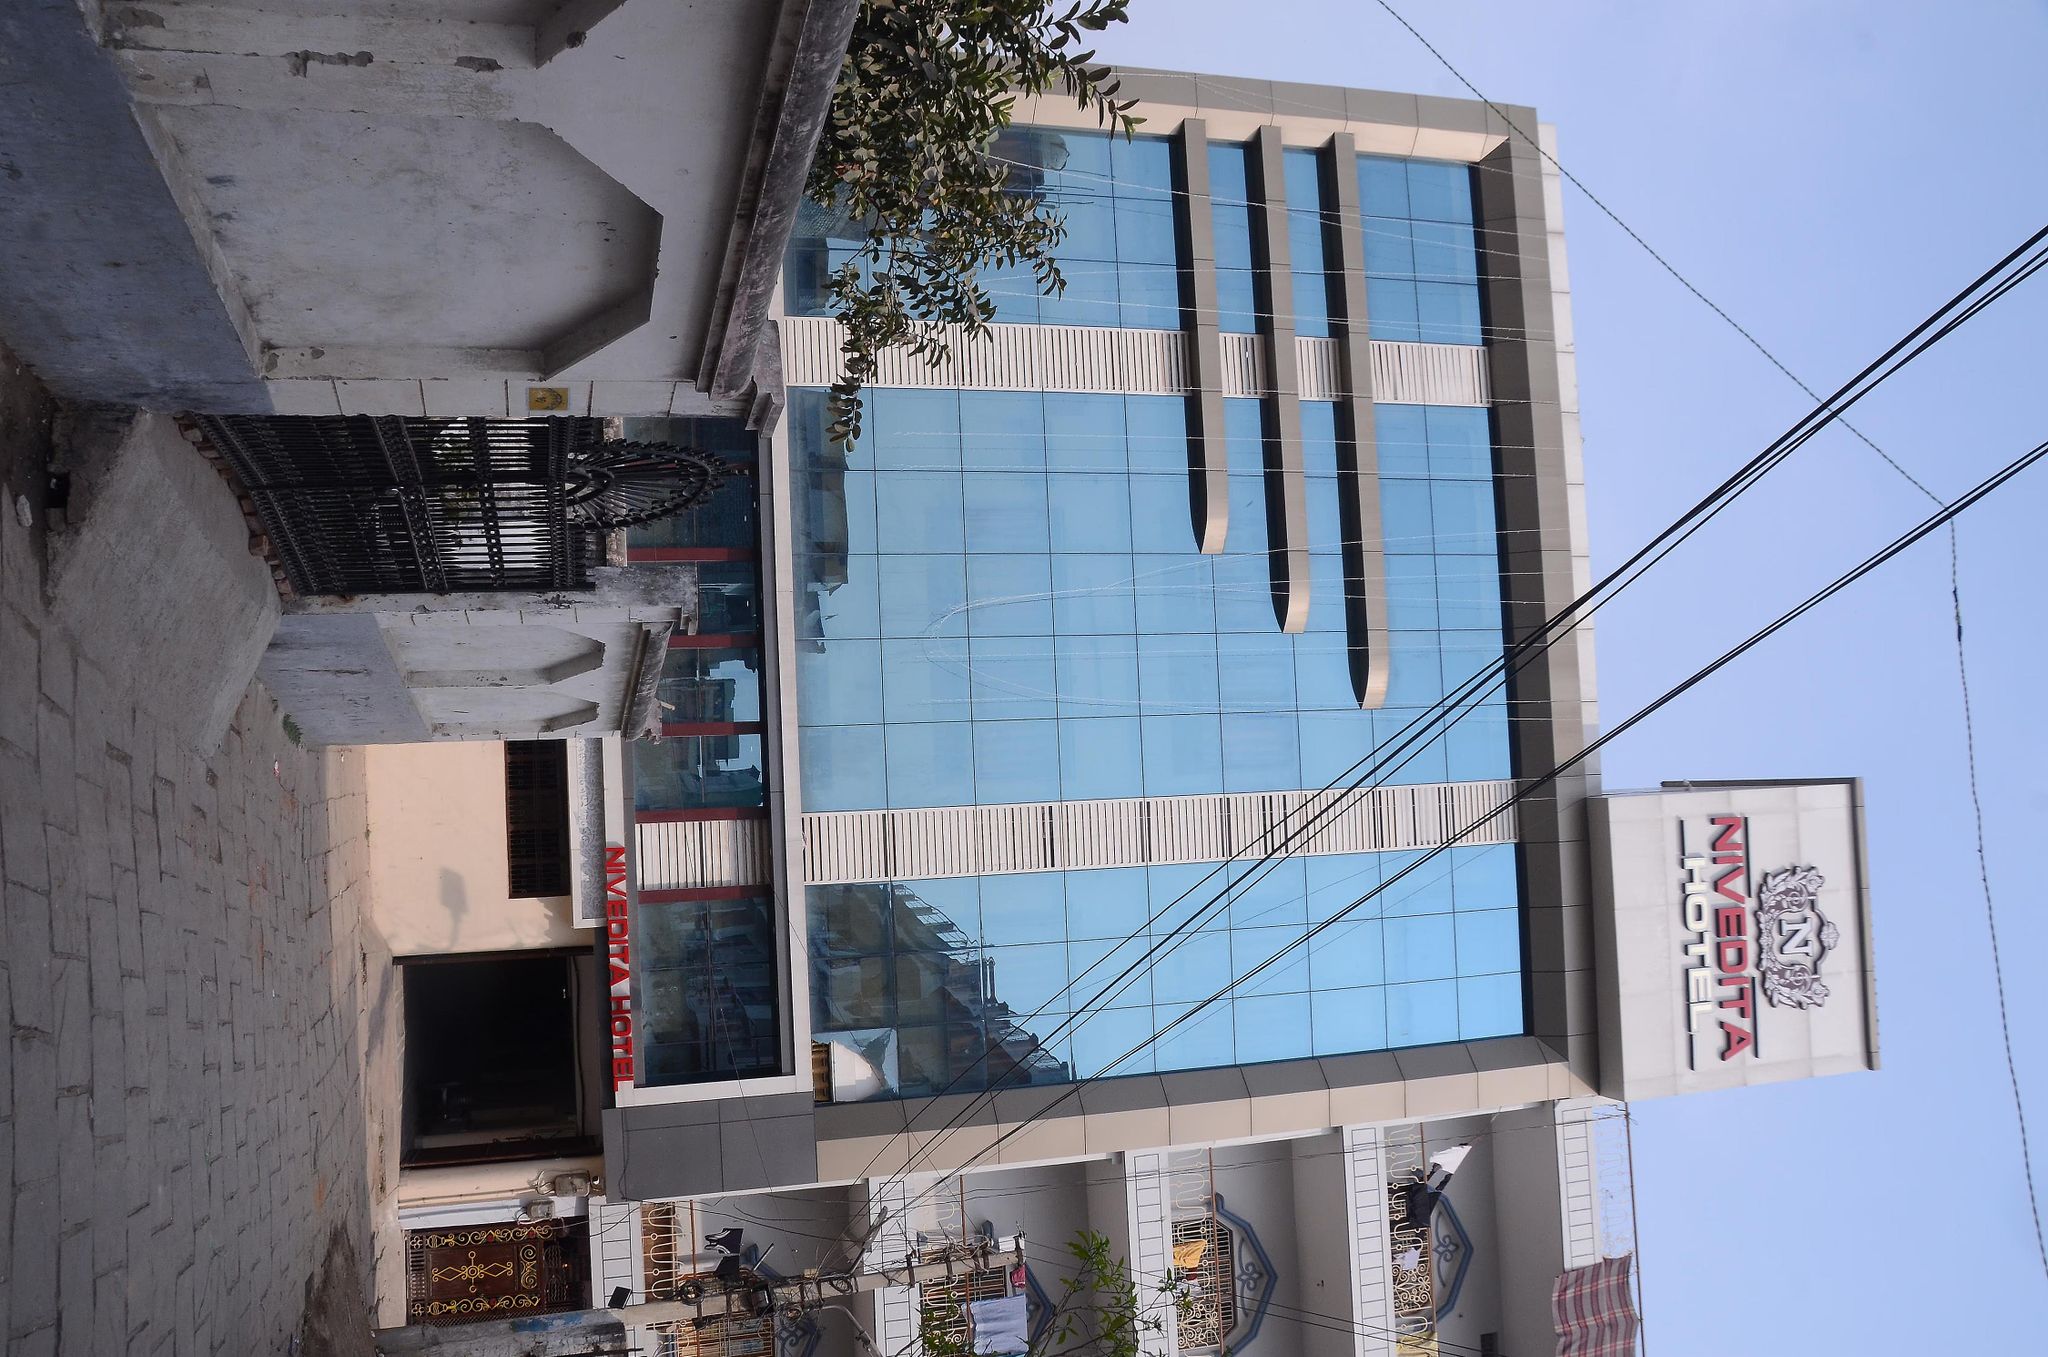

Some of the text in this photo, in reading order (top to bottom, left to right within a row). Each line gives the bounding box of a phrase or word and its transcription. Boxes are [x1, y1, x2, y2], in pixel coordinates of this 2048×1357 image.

[605, 847, 634, 1091] NIVEDITA HOTEL
[1682, 857, 1712, 1032] HOTEL
[1711, 817, 1752, 1061] NIVEDITA
[1779, 916, 1813, 957] N
